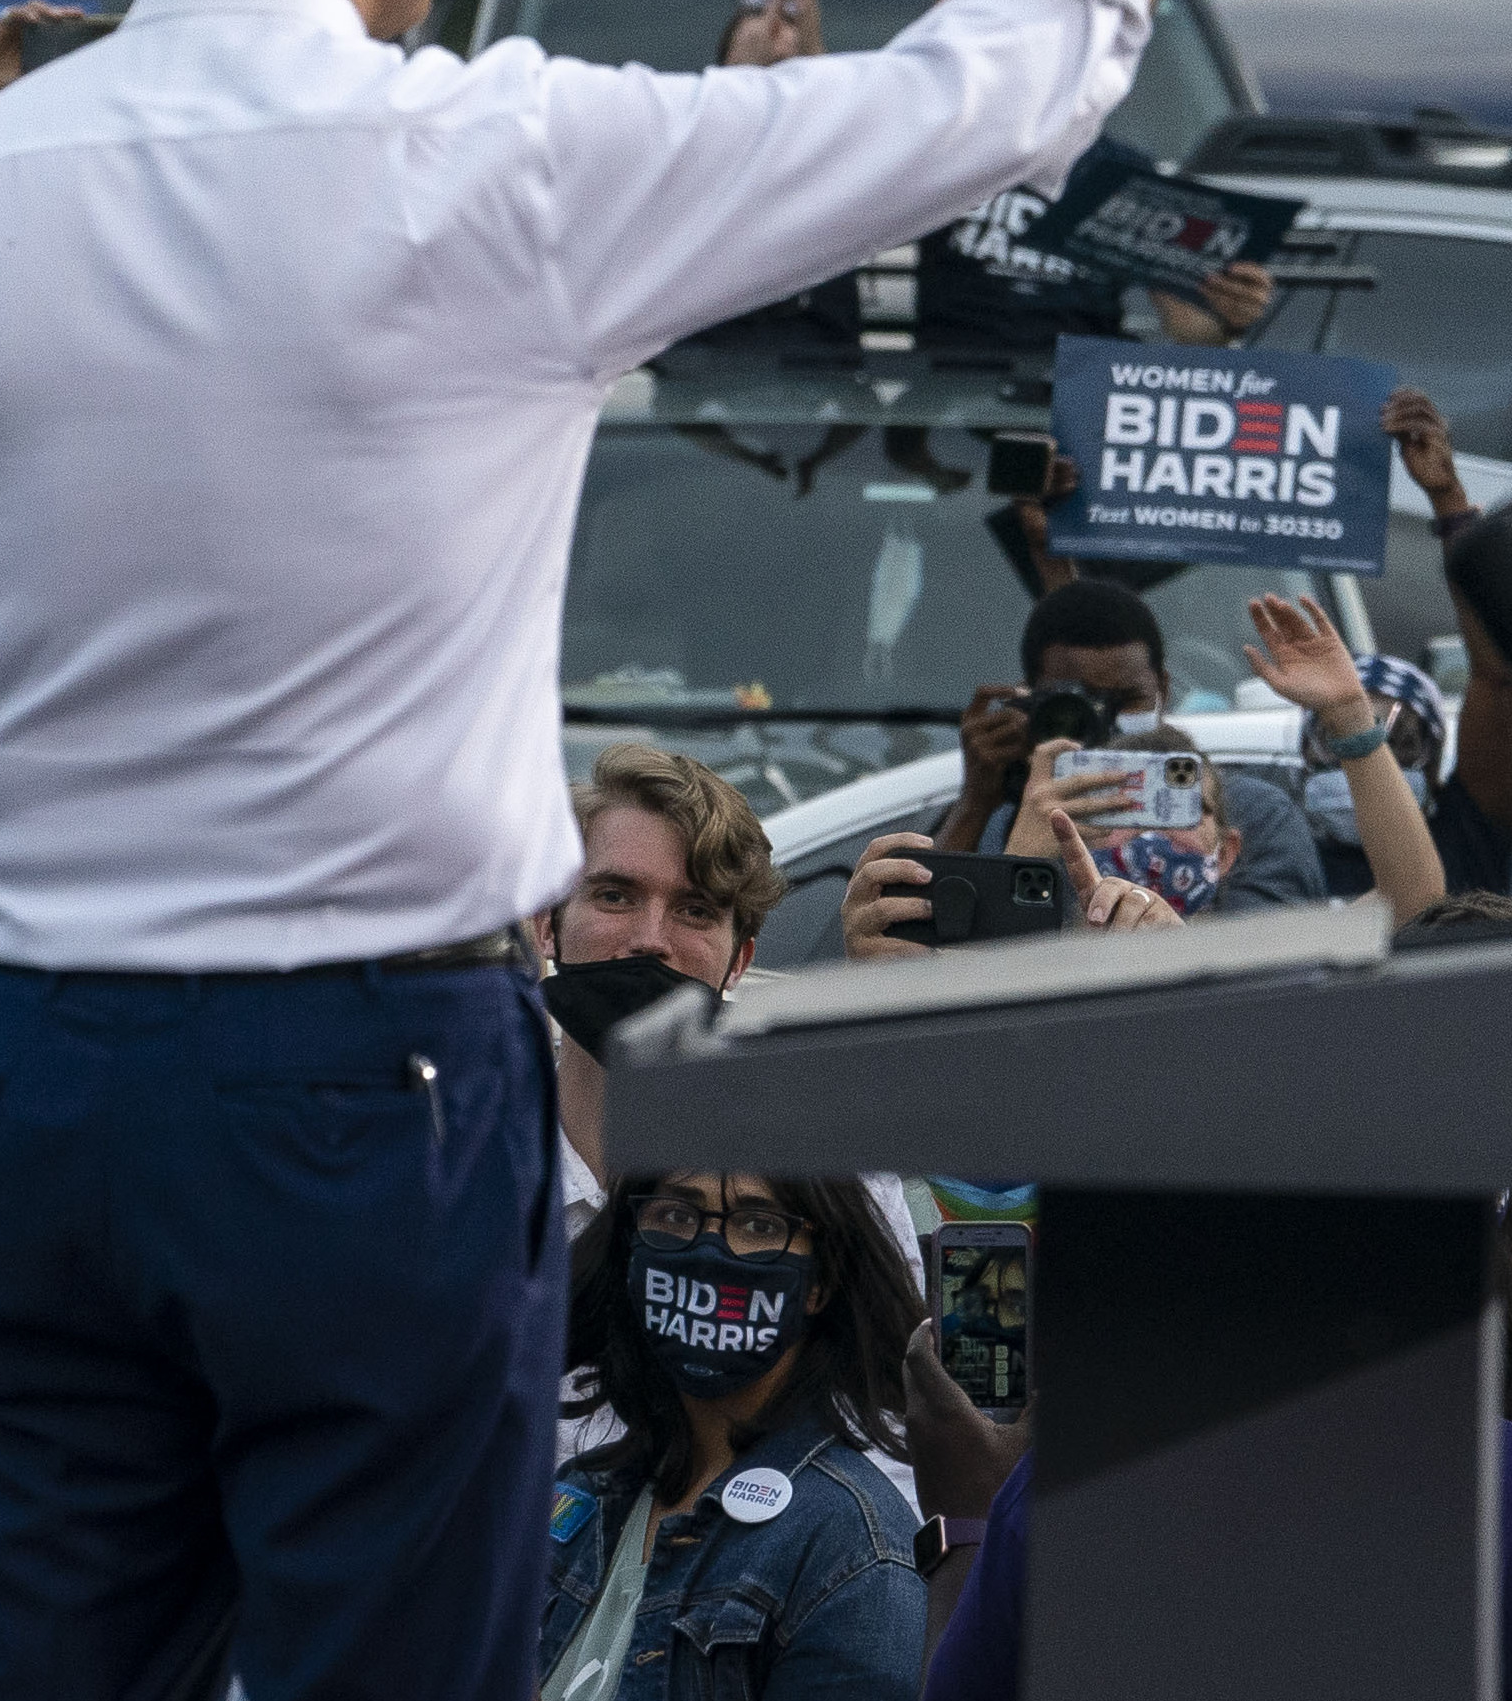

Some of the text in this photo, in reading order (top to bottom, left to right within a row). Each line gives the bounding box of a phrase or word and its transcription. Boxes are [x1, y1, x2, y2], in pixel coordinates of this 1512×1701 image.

[1110, 363, 1277, 399] WOMEN for
[1104, 392, 1339, 458] BIDEN
[1099, 449, 1336, 508] HARRIS
[1134, 506, 1237, 531] WOMEN
[1263, 515, 1344, 540] 30330
[644, 1266, 785, 1323] BIDEN
[644, 1304, 780, 1352] HARRIS
[727, 1489, 777, 1508] HARRIS
[731, 1480, 783, 1500] BIDEN
